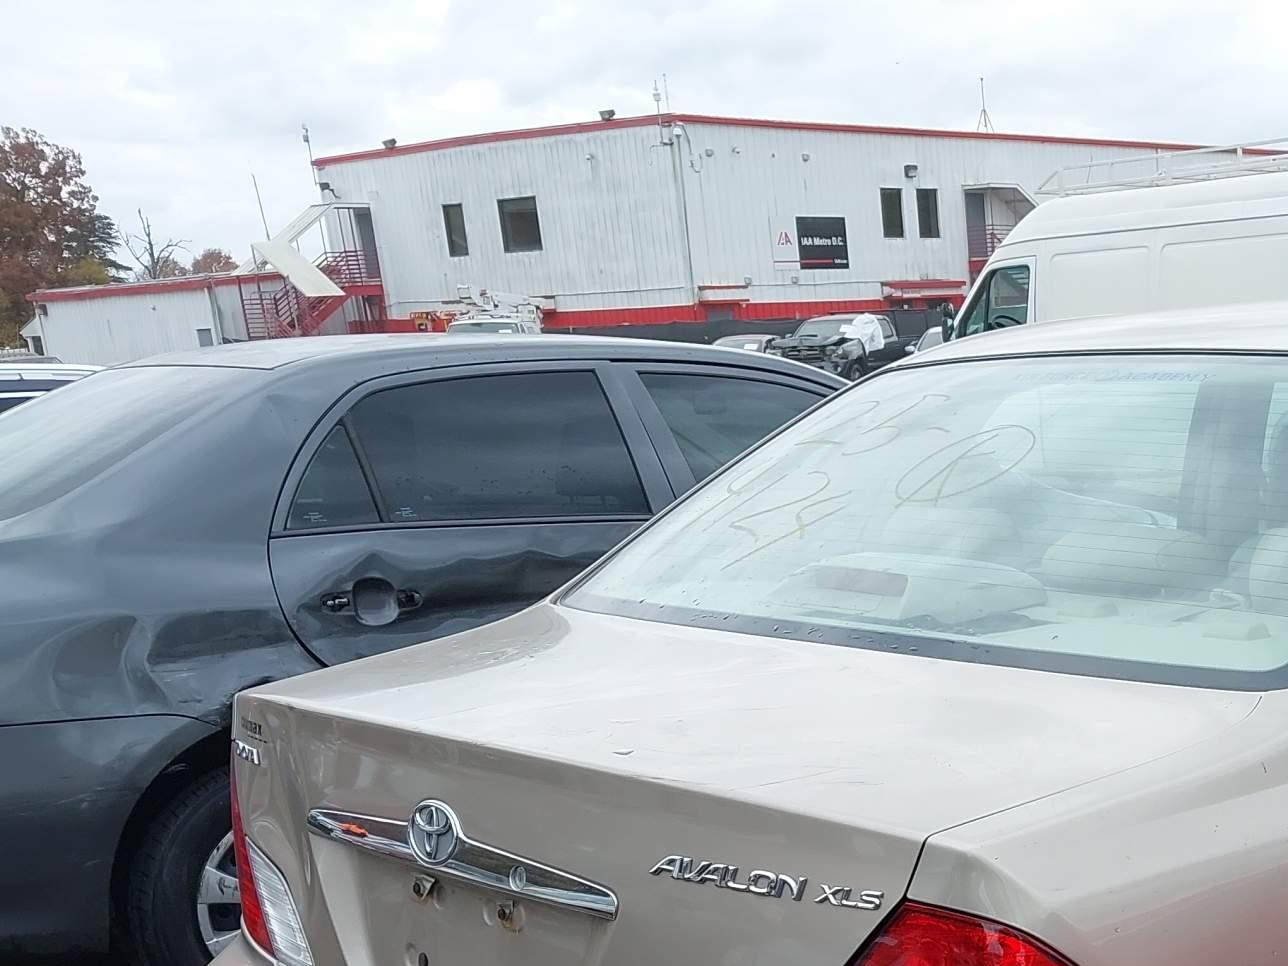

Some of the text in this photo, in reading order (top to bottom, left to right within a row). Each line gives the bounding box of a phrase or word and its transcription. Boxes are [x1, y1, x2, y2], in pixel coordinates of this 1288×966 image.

[801, 237, 812, 246] IAA
[814, 237, 831, 246] Metro
[1122, 370, 1216, 383] ACADEMY
[649, 854, 884, 910] AVALON XLS
